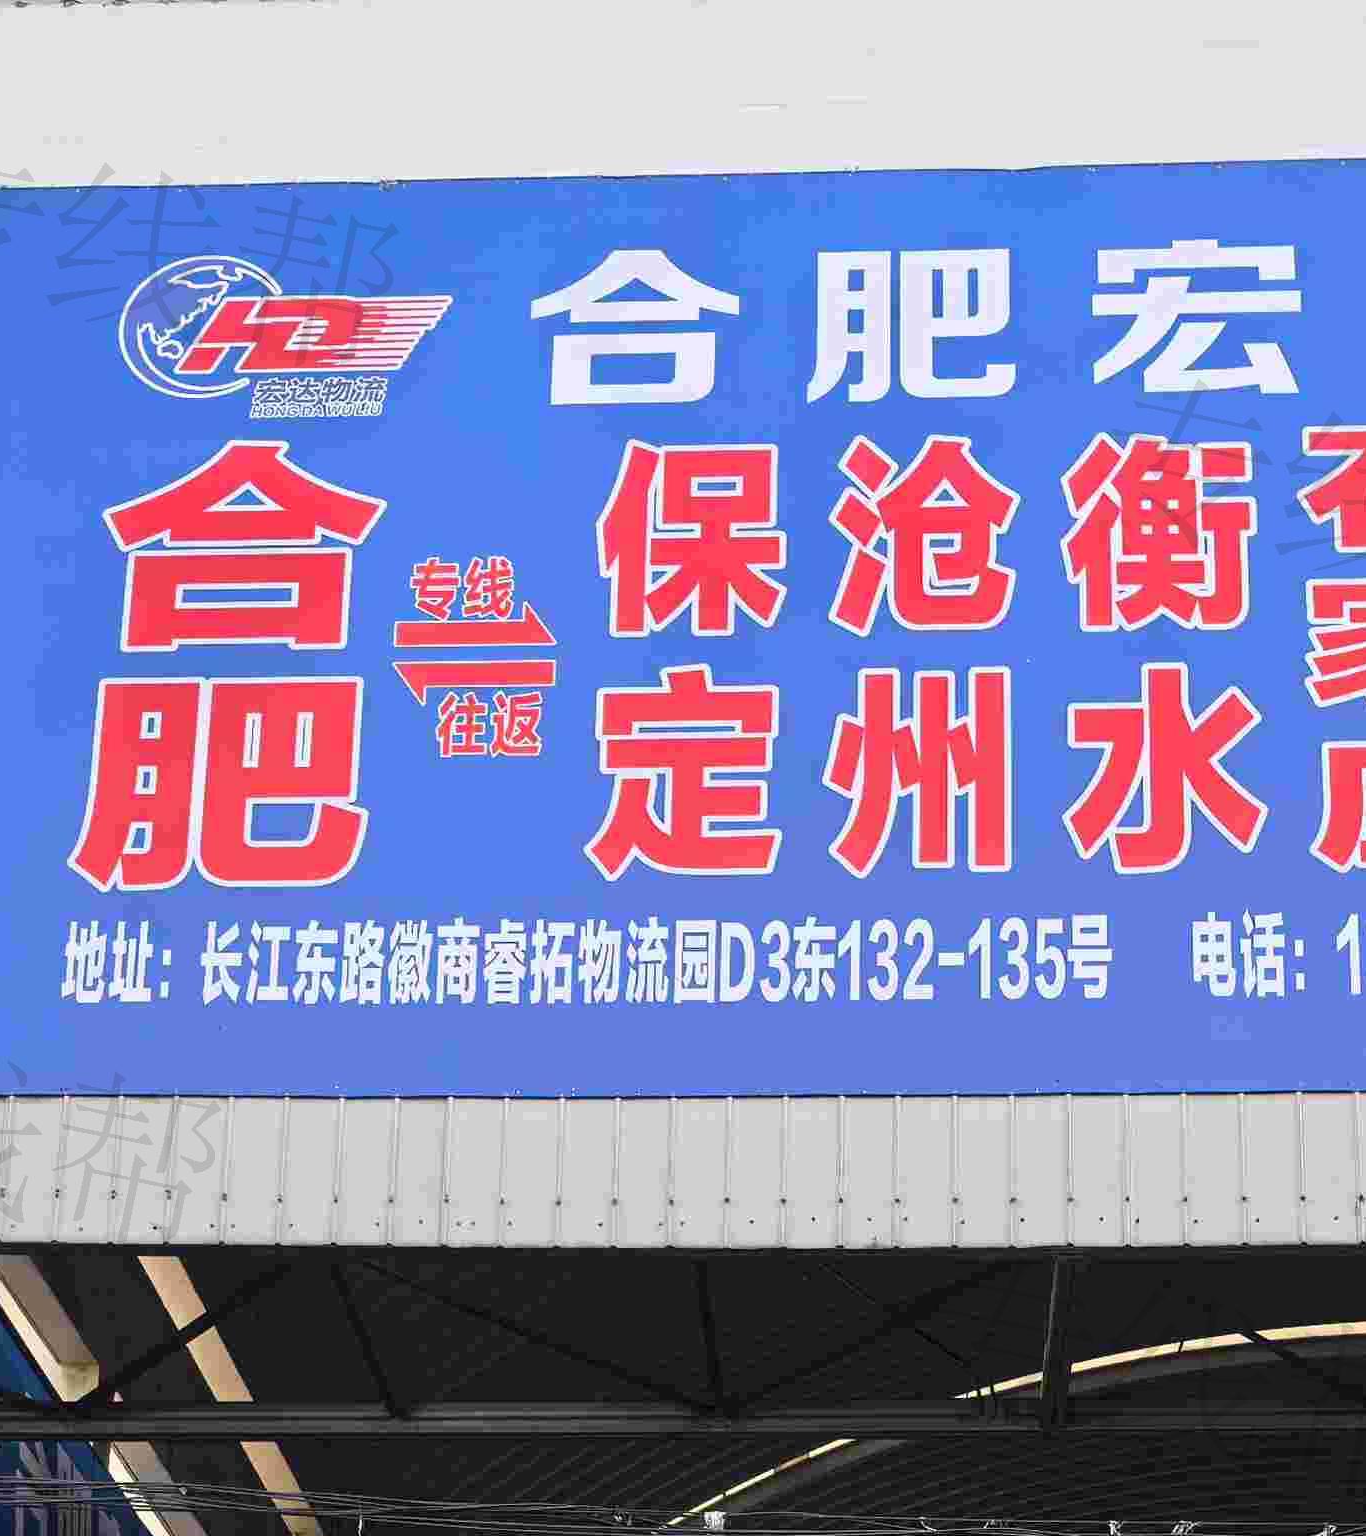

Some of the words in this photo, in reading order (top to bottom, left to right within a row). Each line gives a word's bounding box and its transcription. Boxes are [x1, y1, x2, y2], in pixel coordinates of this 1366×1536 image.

[252, 376, 388, 403] 宏达物流
[67, 440, 387, 892] 合肥
[410, 556, 517, 622] 专线
[585, 440, 787, 881] 保定
[823, 435, 1020, 878] 沧州
[1061, 433, 1268, 873] 衡水
[436, 692, 544, 758] 往返
[202, 915, 1112, 1004] 长江东路徽商睿拓物流园D3东132-135号
